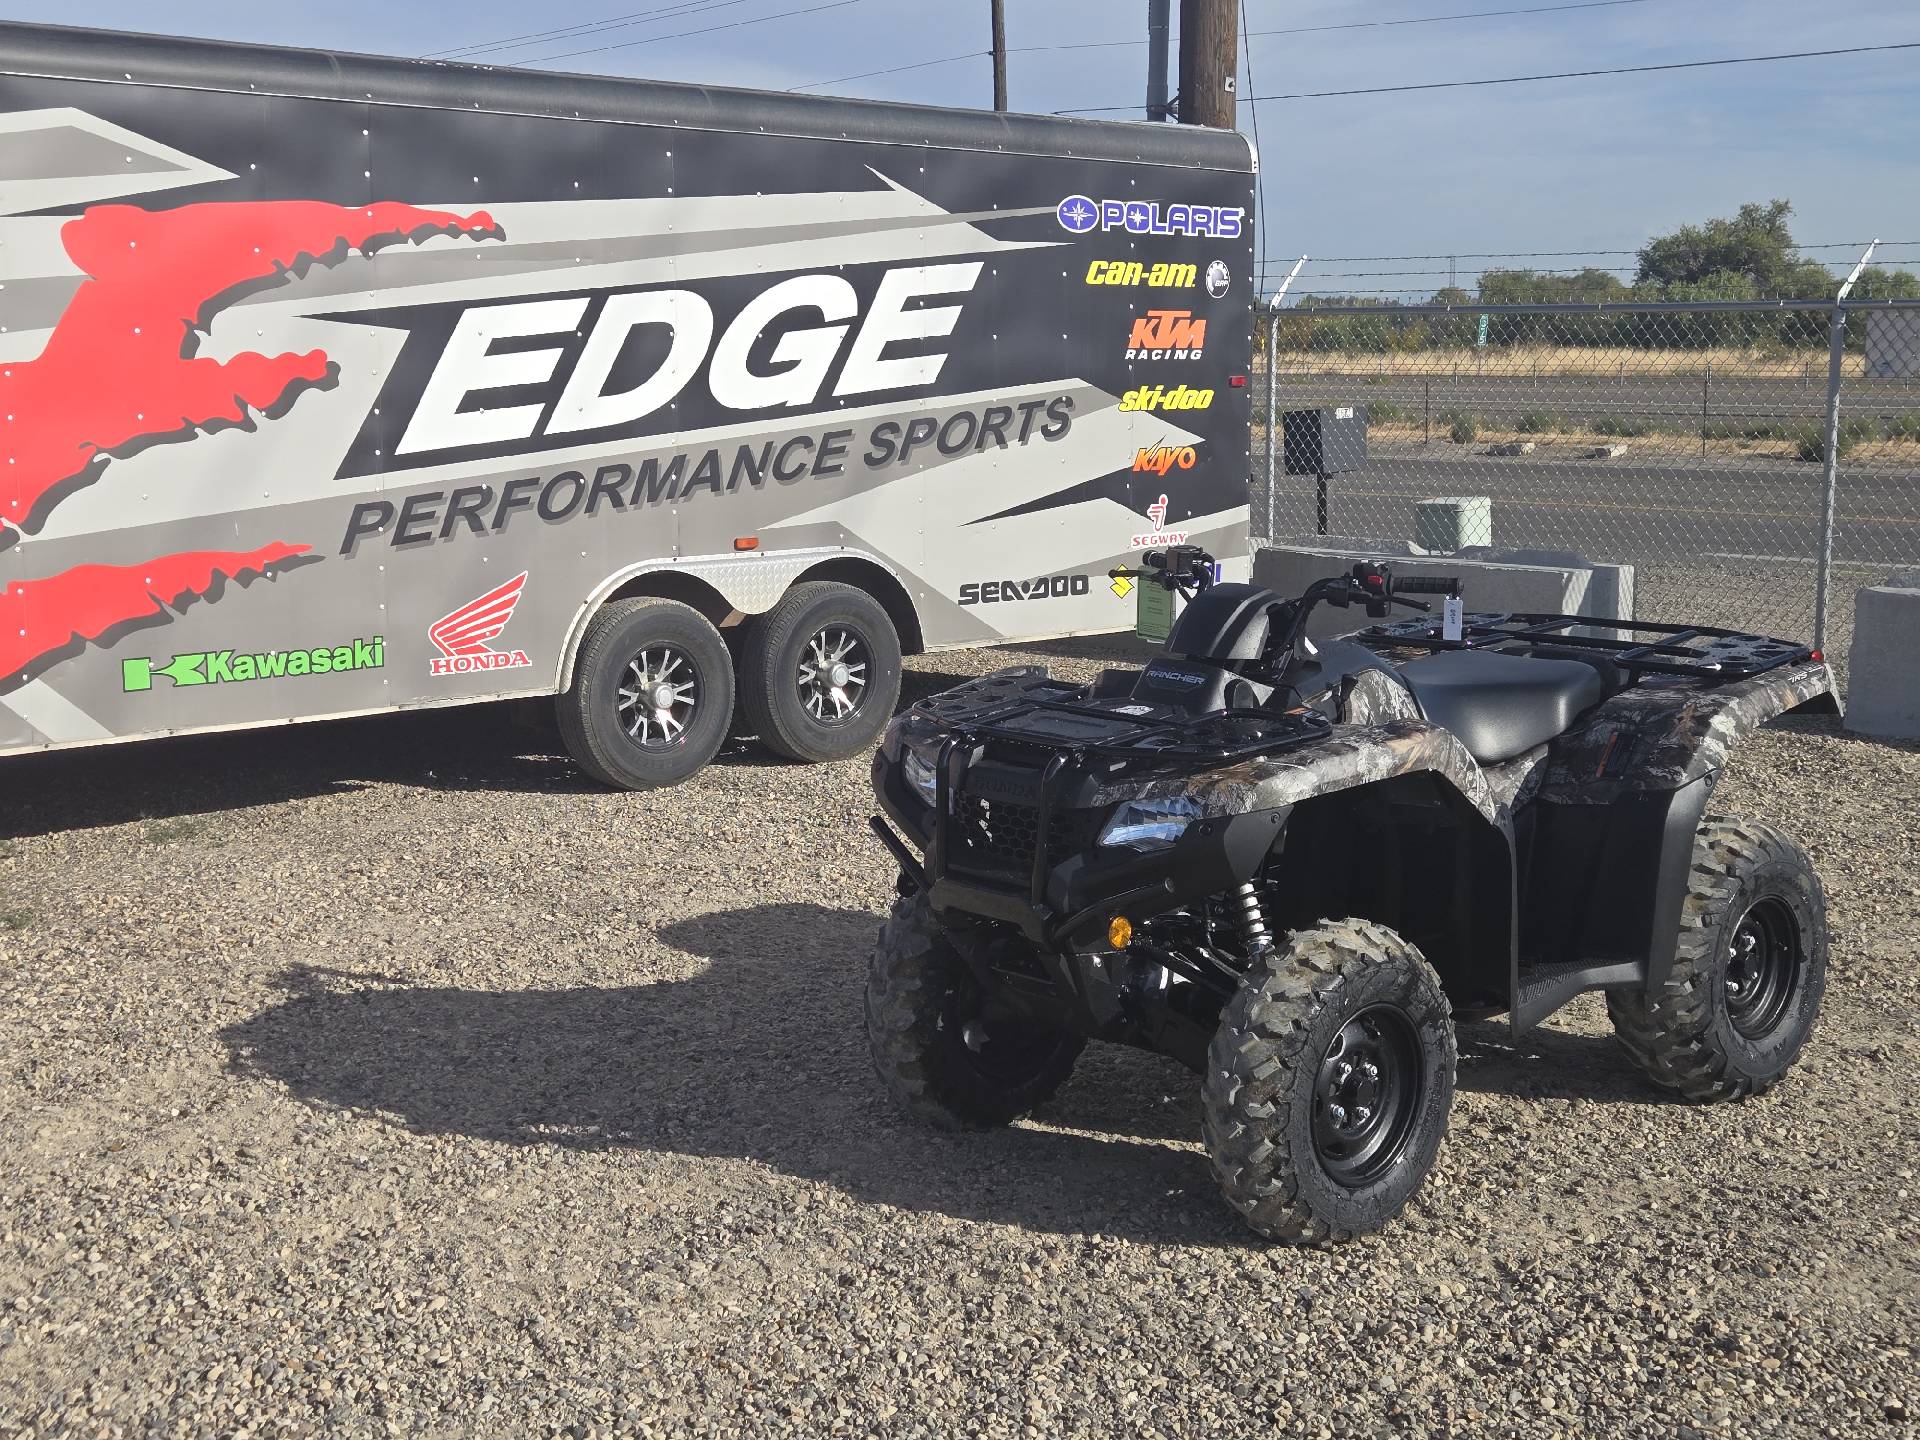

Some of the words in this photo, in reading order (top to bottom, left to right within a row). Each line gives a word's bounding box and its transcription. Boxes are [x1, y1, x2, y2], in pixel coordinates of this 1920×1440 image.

[1101, 199, 1244, 239] POLARIS
[1128, 310, 1207, 349] KTM
[395, 262, 984, 455] EDGE
[1125, 349, 1203, 361] RACING
[1118, 384, 1215, 412] ski-doo
[1132, 440, 1197, 476] KAYO
[338, 430, 855, 558] PERFORMANCE
[862, 395, 1075, 468] SPORTS
[1131, 532, 1188, 548] SEGWAY
[206, 635, 384, 686] Kawasaki
[430, 648, 532, 677] HONDA
[1146, 670, 1206, 685] RANCHER
